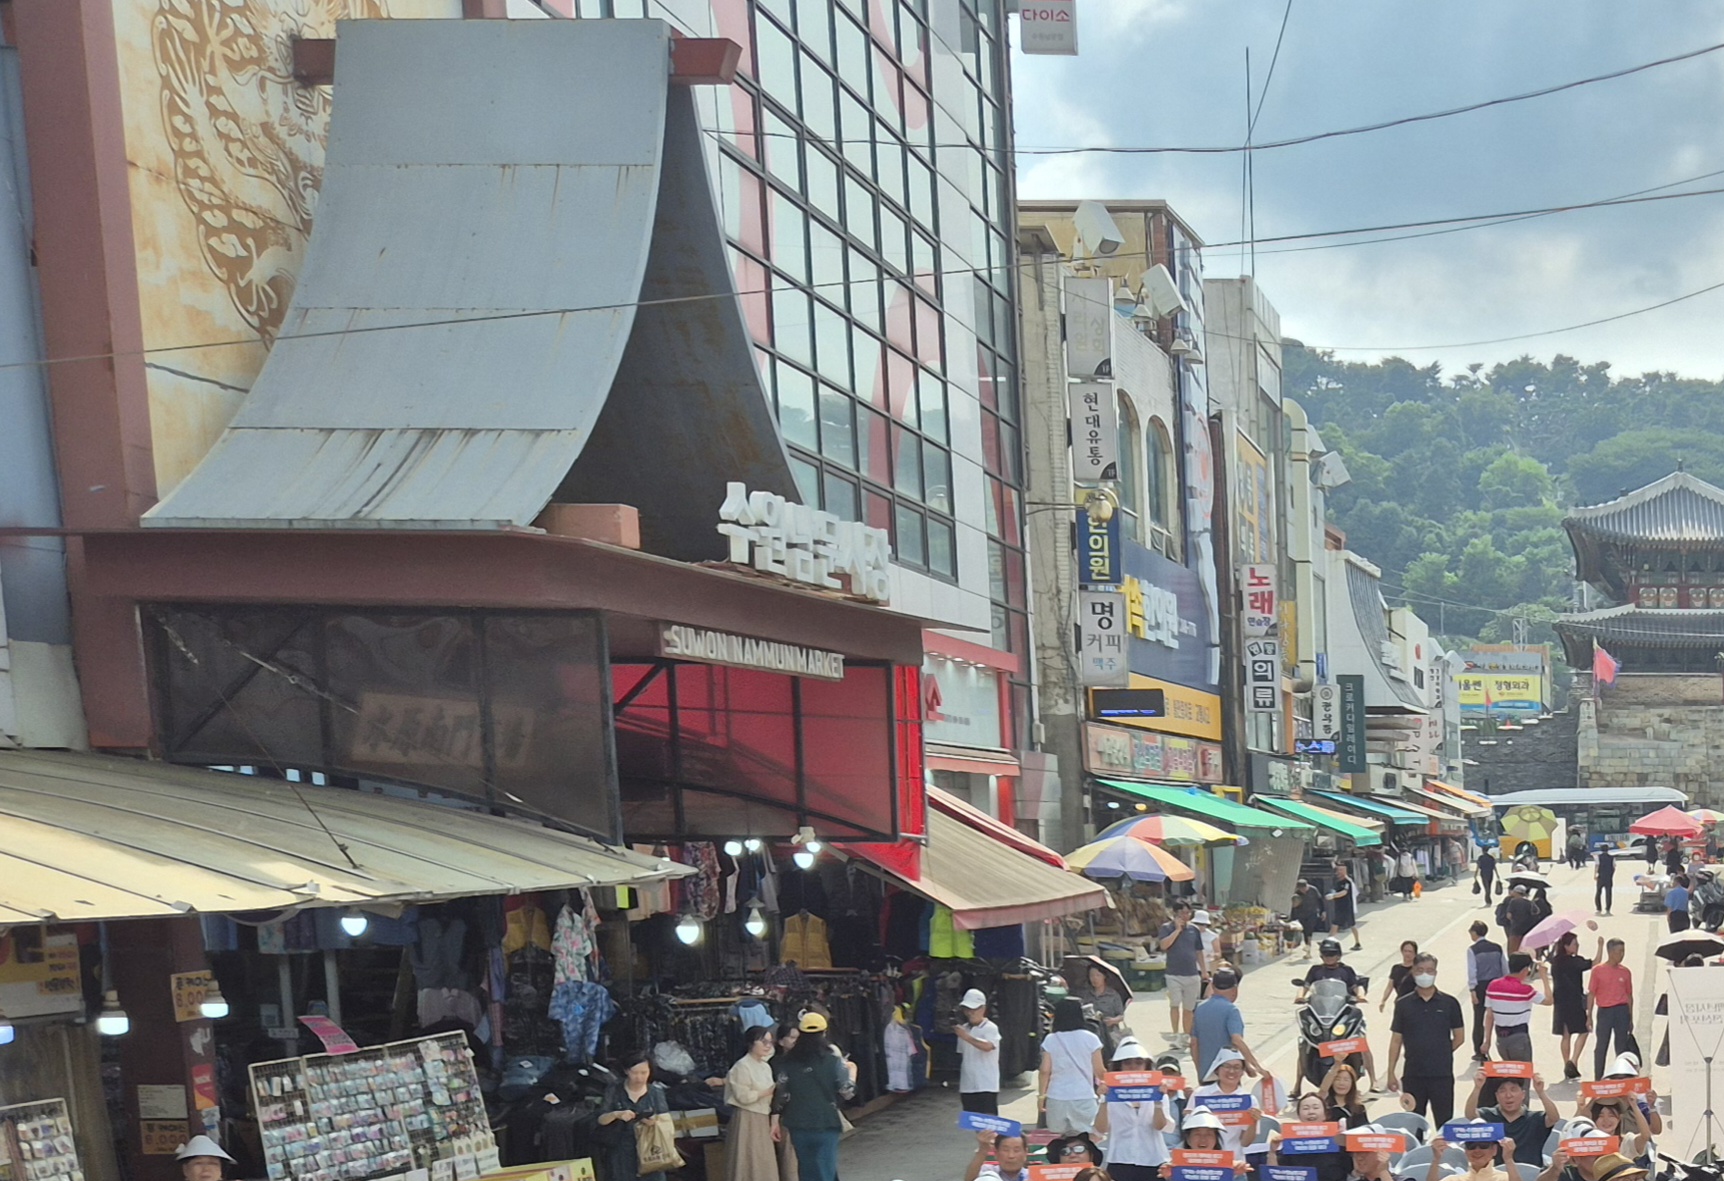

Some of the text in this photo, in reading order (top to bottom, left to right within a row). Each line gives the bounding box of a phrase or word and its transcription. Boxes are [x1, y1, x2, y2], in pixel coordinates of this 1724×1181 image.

[1022, 8, 1070, 23] 다이소
[1083, 392, 1103, 466] 현대유통
[1247, 567, 1274, 615] 노래
[1091, 602, 1114, 630] 명
[664, 625, 845, 679] SUWON NAMMUN MARKET
[1087, 634, 1122, 652] 커피
[1093, 657, 1117, 670] 맥주
[1251, 660, 1276, 709] 의류
[1495, 679, 1530, 691] 정형외과
